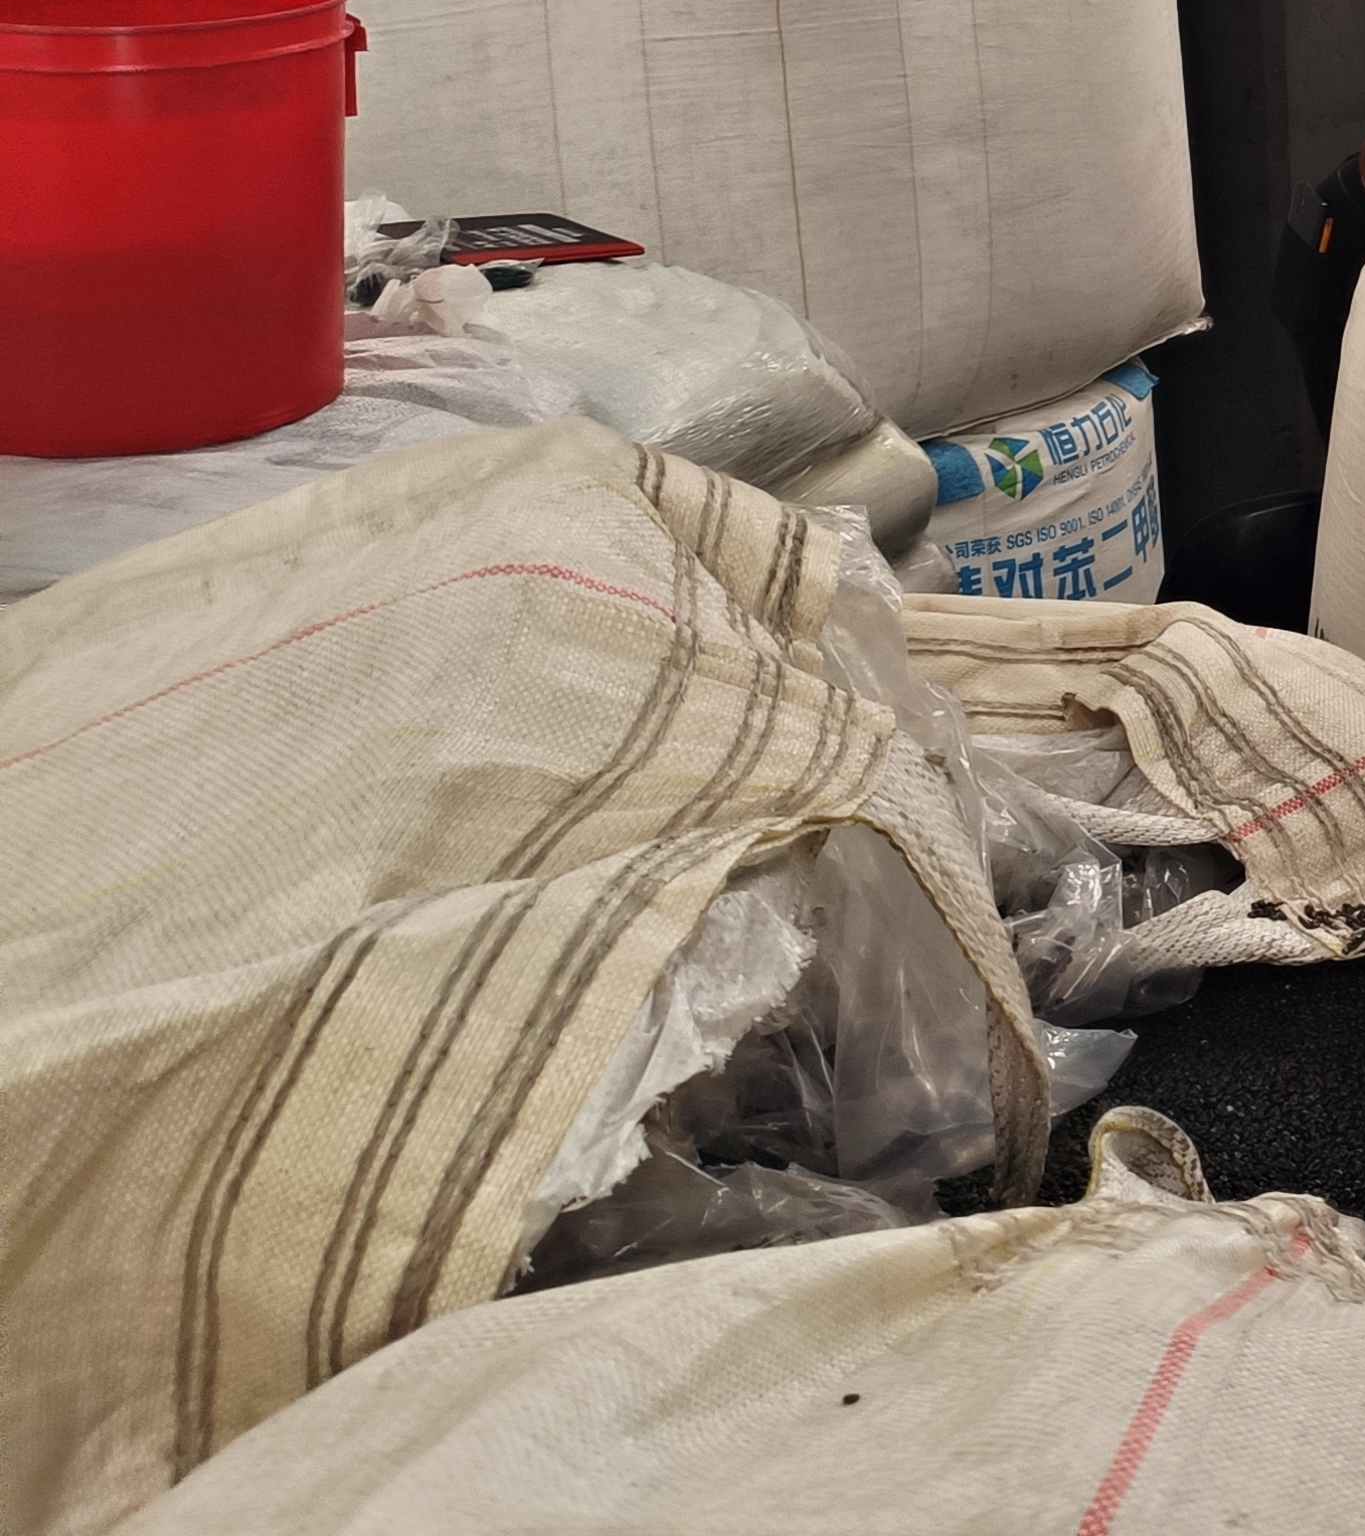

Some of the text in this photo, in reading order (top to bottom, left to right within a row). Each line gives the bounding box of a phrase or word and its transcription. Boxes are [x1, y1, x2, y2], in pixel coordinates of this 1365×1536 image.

[1039, 392, 1133, 466] 恒力石化
[1052, 465, 1088, 485] HENGLI
[945, 535, 1002, 560] 司荣获
[1006, 531, 1033, 550] SGS
[1037, 524, 1057, 543] ISO
[1087, 507, 1104, 525] ISO
